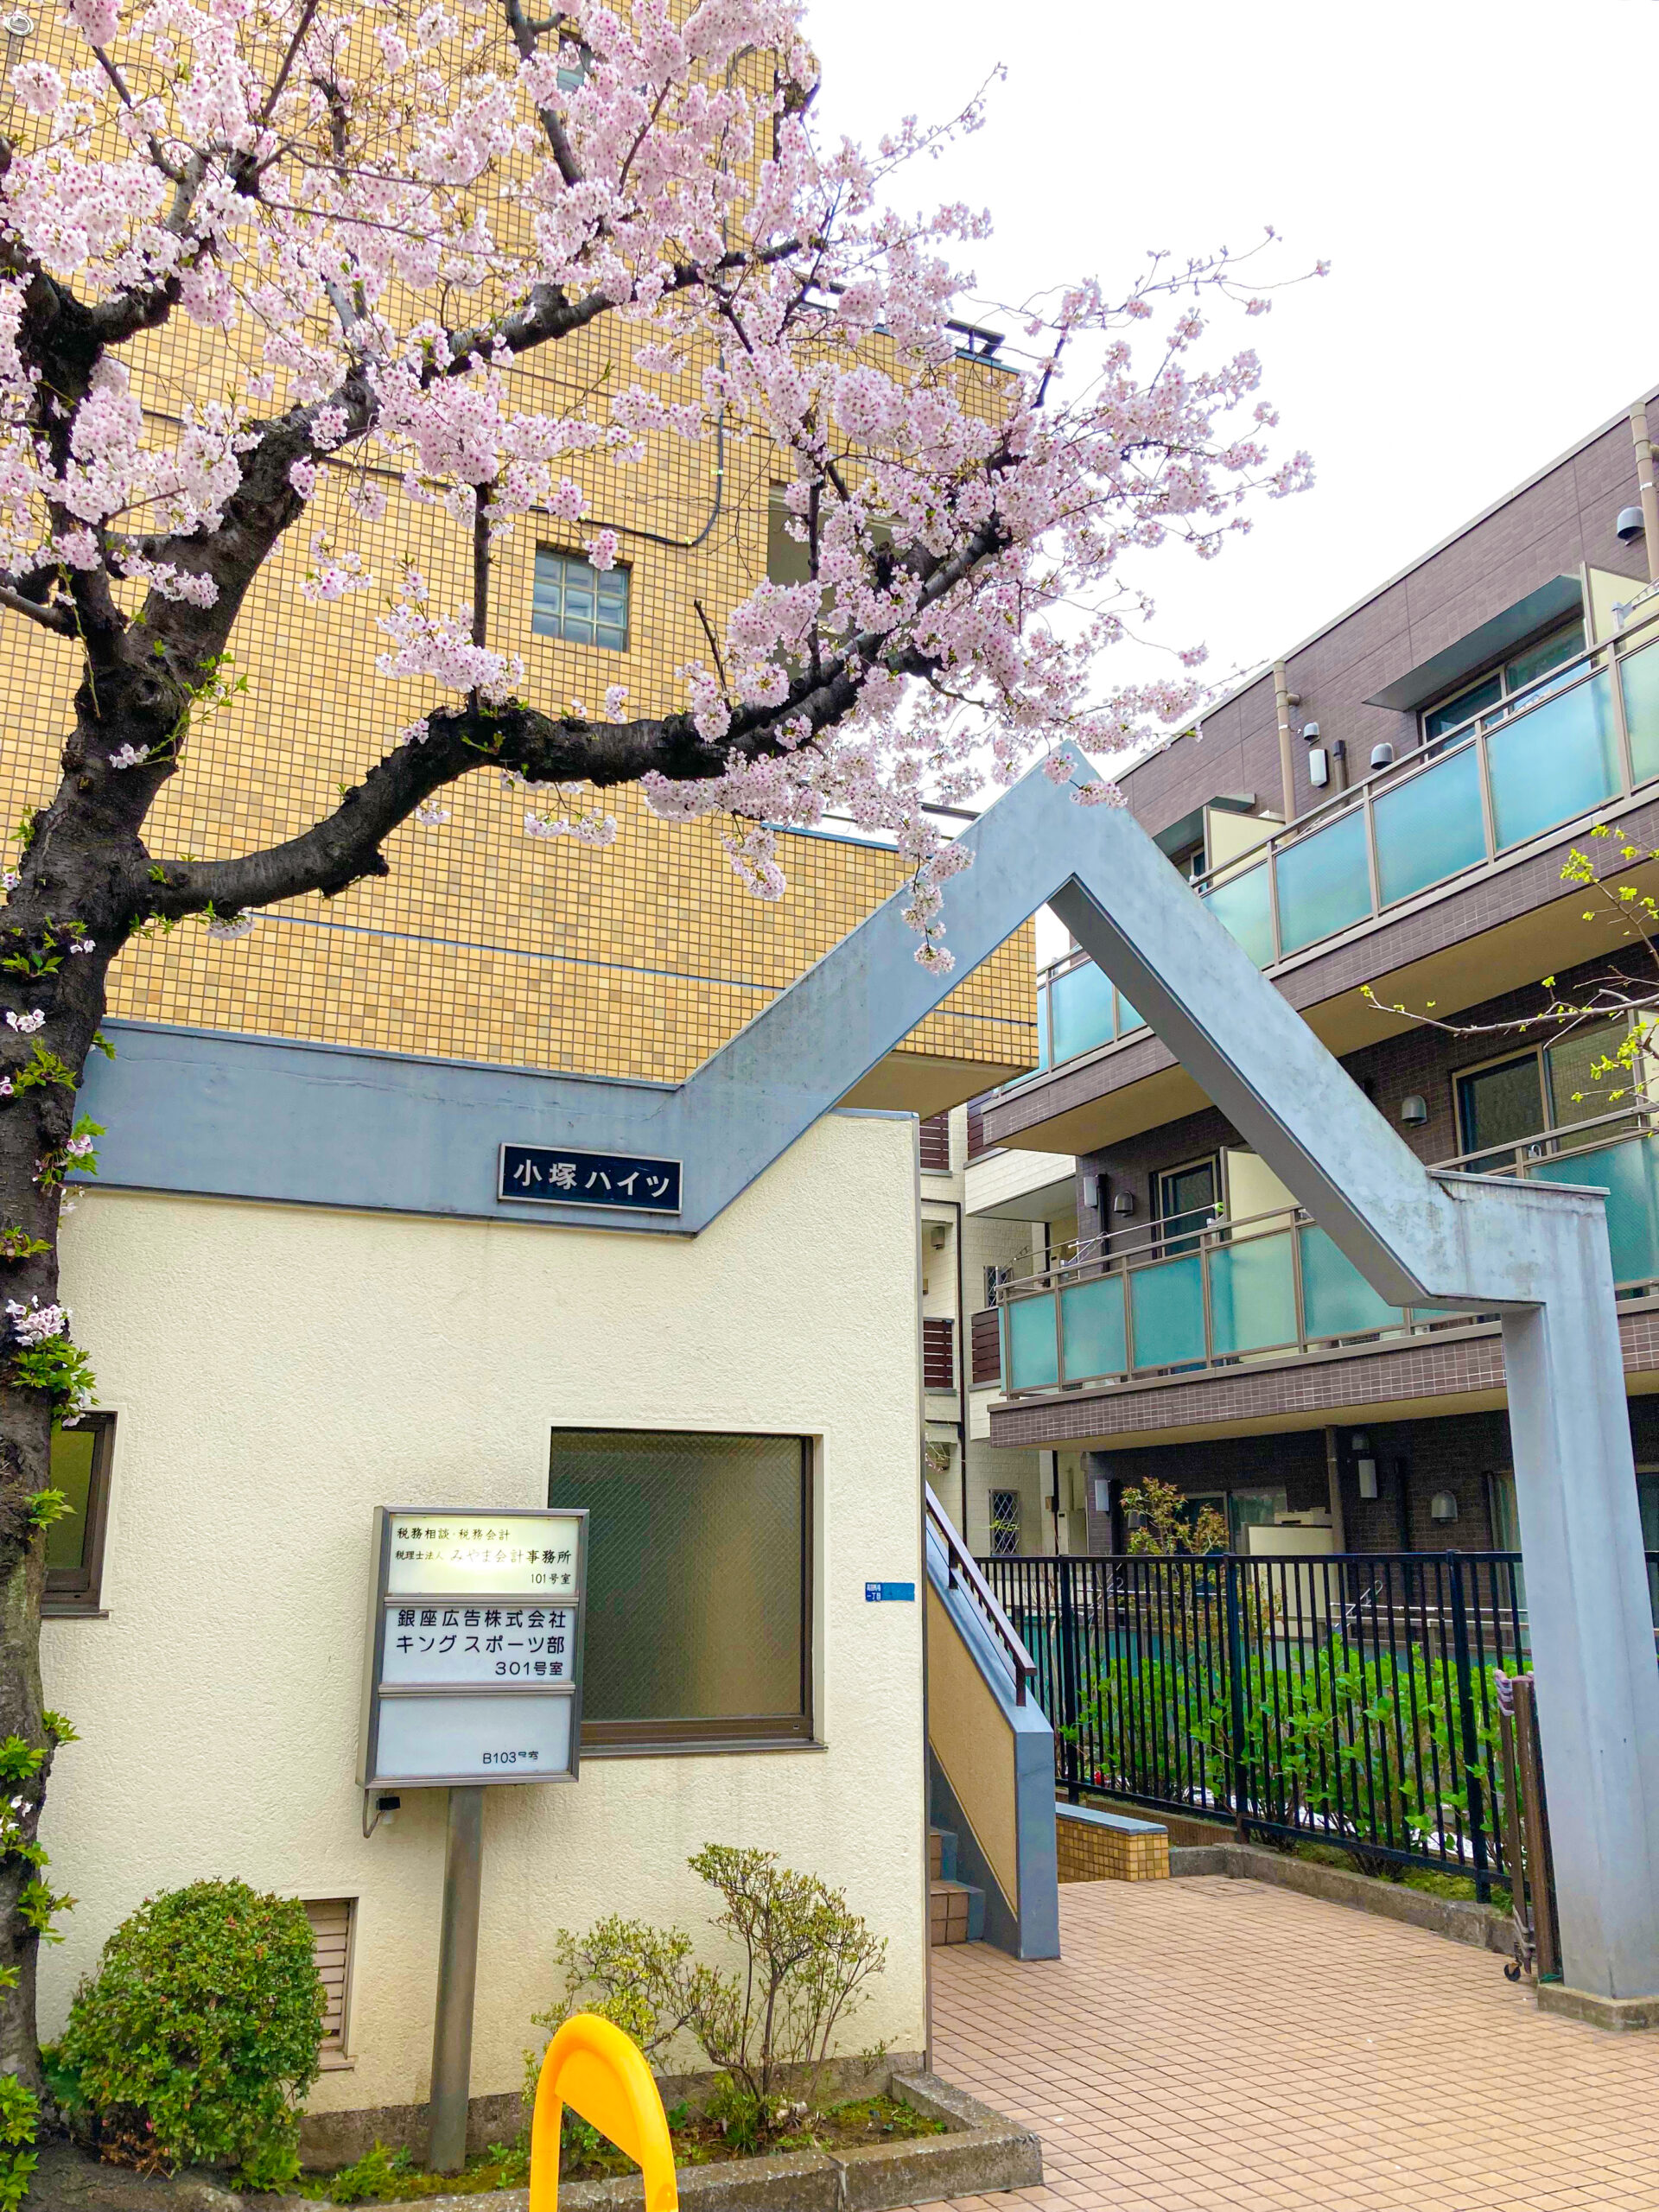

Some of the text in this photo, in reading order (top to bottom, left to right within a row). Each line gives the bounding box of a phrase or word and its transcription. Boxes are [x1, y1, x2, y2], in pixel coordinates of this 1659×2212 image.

[513, 1159, 670, 1198] 小塚ハイツ
[395, 1549, 572, 1565] 税理士法人 みやま会計事務所
[531, 1573, 571, 1585] 101号室
[397, 1609, 566, 1629] 銀座広告株式会社
[495, 1662, 563, 1676] 301号室
